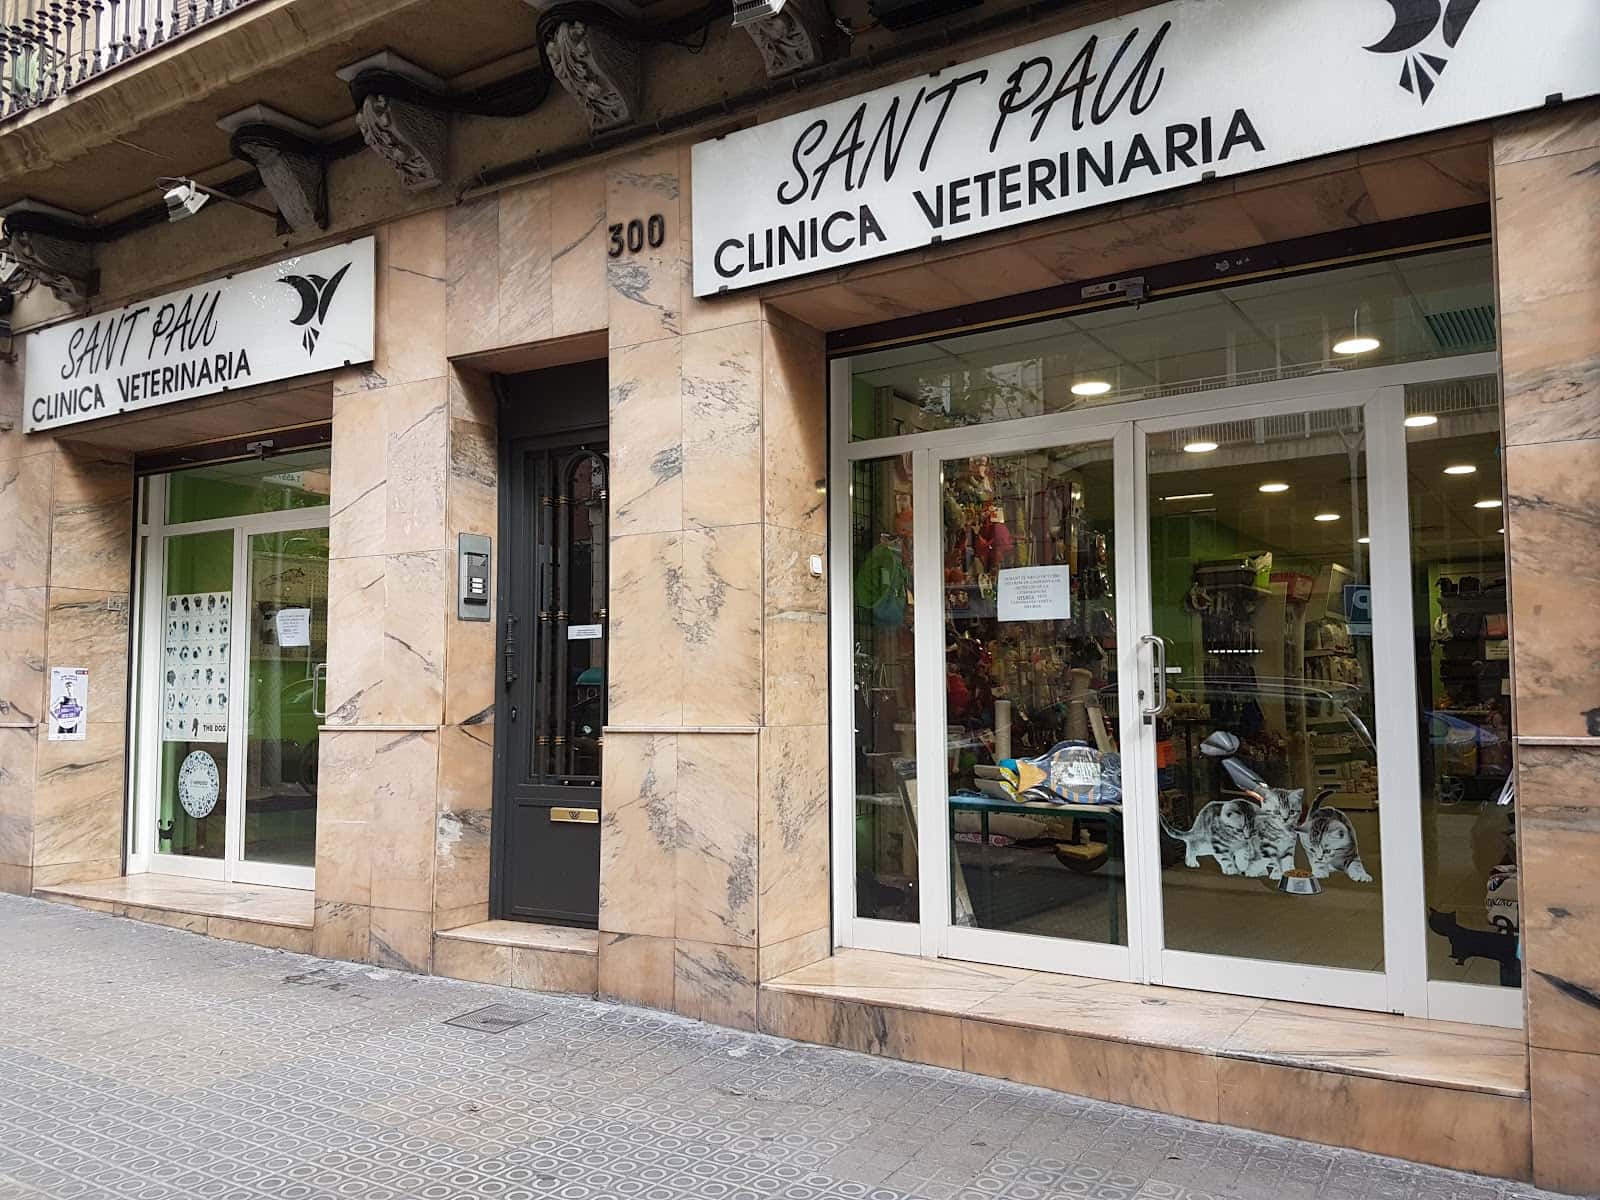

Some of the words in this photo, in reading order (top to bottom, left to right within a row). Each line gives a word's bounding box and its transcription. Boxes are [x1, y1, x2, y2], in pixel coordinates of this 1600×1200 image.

[778, 70, 988, 205] SANT
[989, 20, 1172, 153] PAU
[714, 204, 888, 279] CLINICA
[913, 108, 1266, 229] VETERINARIA
[608, 214, 665, 257] 300
[61, 306, 150, 380] SANT
[148, 290, 222, 360] PAU
[32, 384, 105, 423] CLINICA
[117, 349, 252, 403] VETERINARIA
[203, 724, 213, 732] THE
[214, 724, 226, 732] DOG
